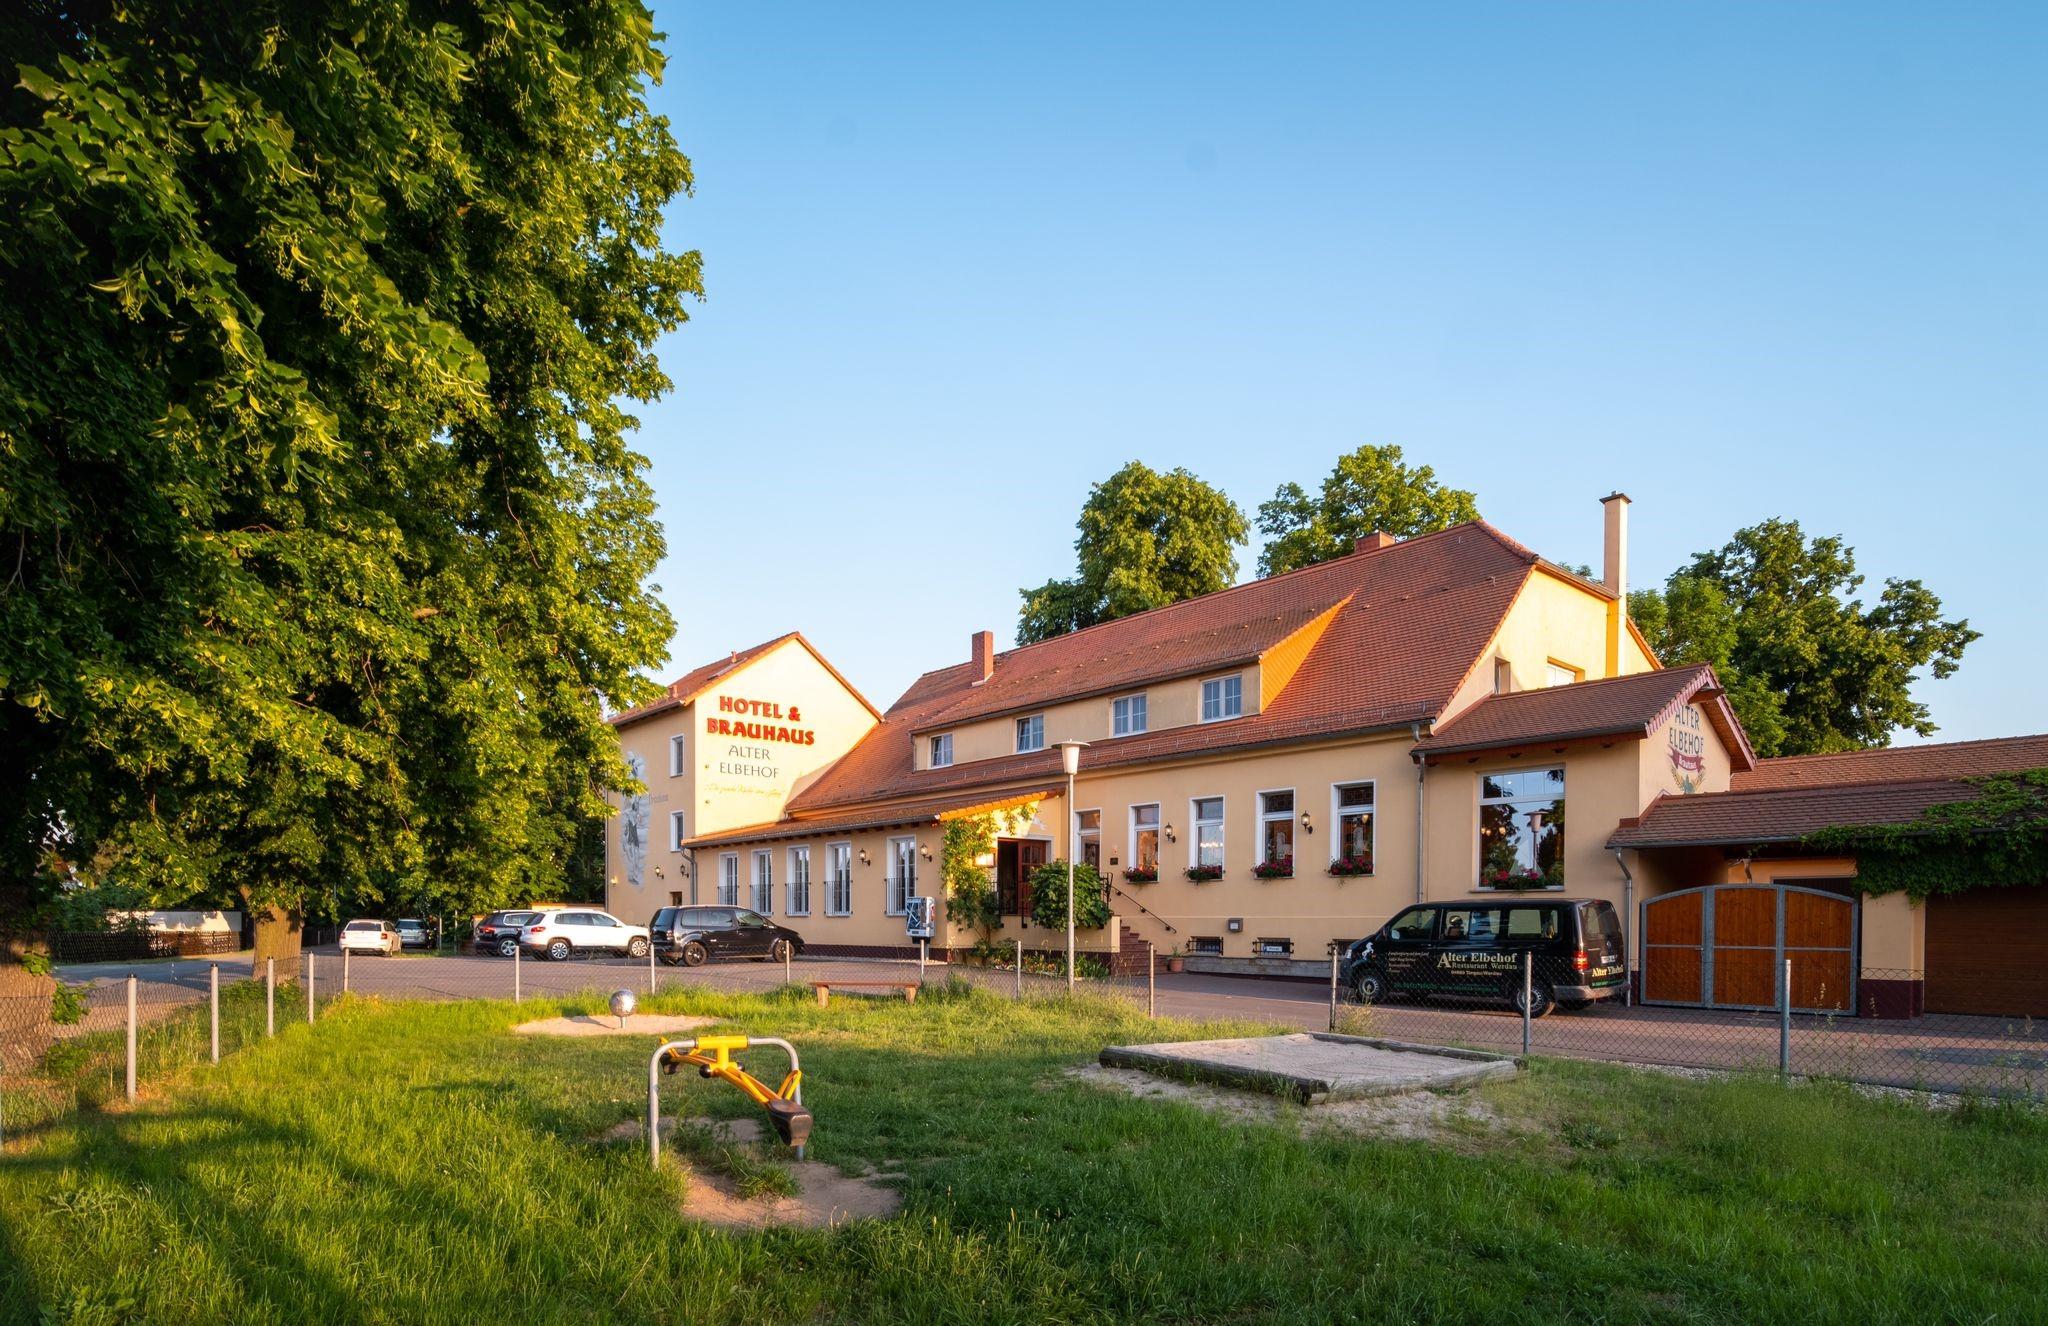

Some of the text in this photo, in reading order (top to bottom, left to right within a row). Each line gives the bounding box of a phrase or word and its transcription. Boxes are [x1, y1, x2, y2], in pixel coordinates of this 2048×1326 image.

[719, 695, 801, 721] HOTEL &
[1674, 704, 1699, 730] ALTER
[707, 717, 815, 746] BRAUHAUS
[1669, 727, 1704, 754] ELBEHOF
[728, 744, 771, 760] ALTER
[719, 761, 780, 779] ELBEHOF
[1436, 951, 1468, 969] Alter
[1471, 952, 1518, 963] Elbehof
[1452, 962, 1488, 970] Restaurant
